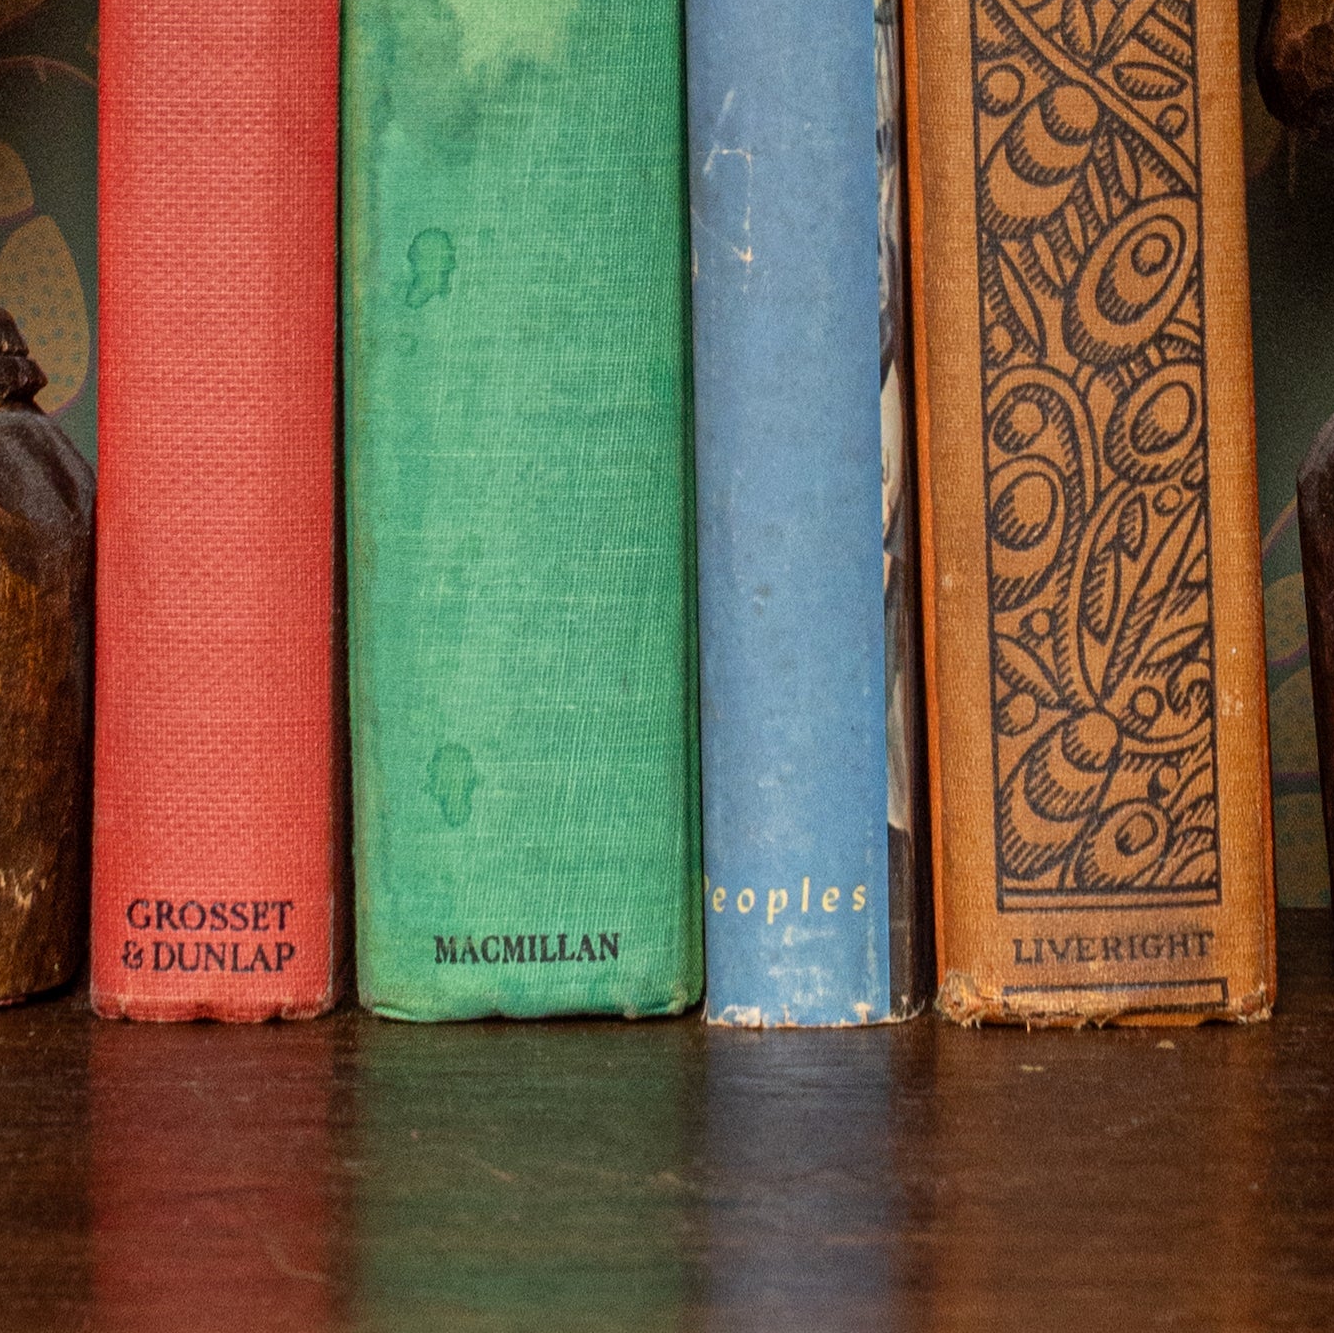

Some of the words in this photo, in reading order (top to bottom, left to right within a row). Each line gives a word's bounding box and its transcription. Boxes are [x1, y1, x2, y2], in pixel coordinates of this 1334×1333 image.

[126, 900, 294, 932] GROSSET
[704, 875, 866, 925] eoples
[122, 941, 143, 970] &
[154, 941, 296, 973] DUNLAP
[433, 932, 620, 965] MACMILLAN
[1013, 930, 1215, 967] LIVERIGHT
